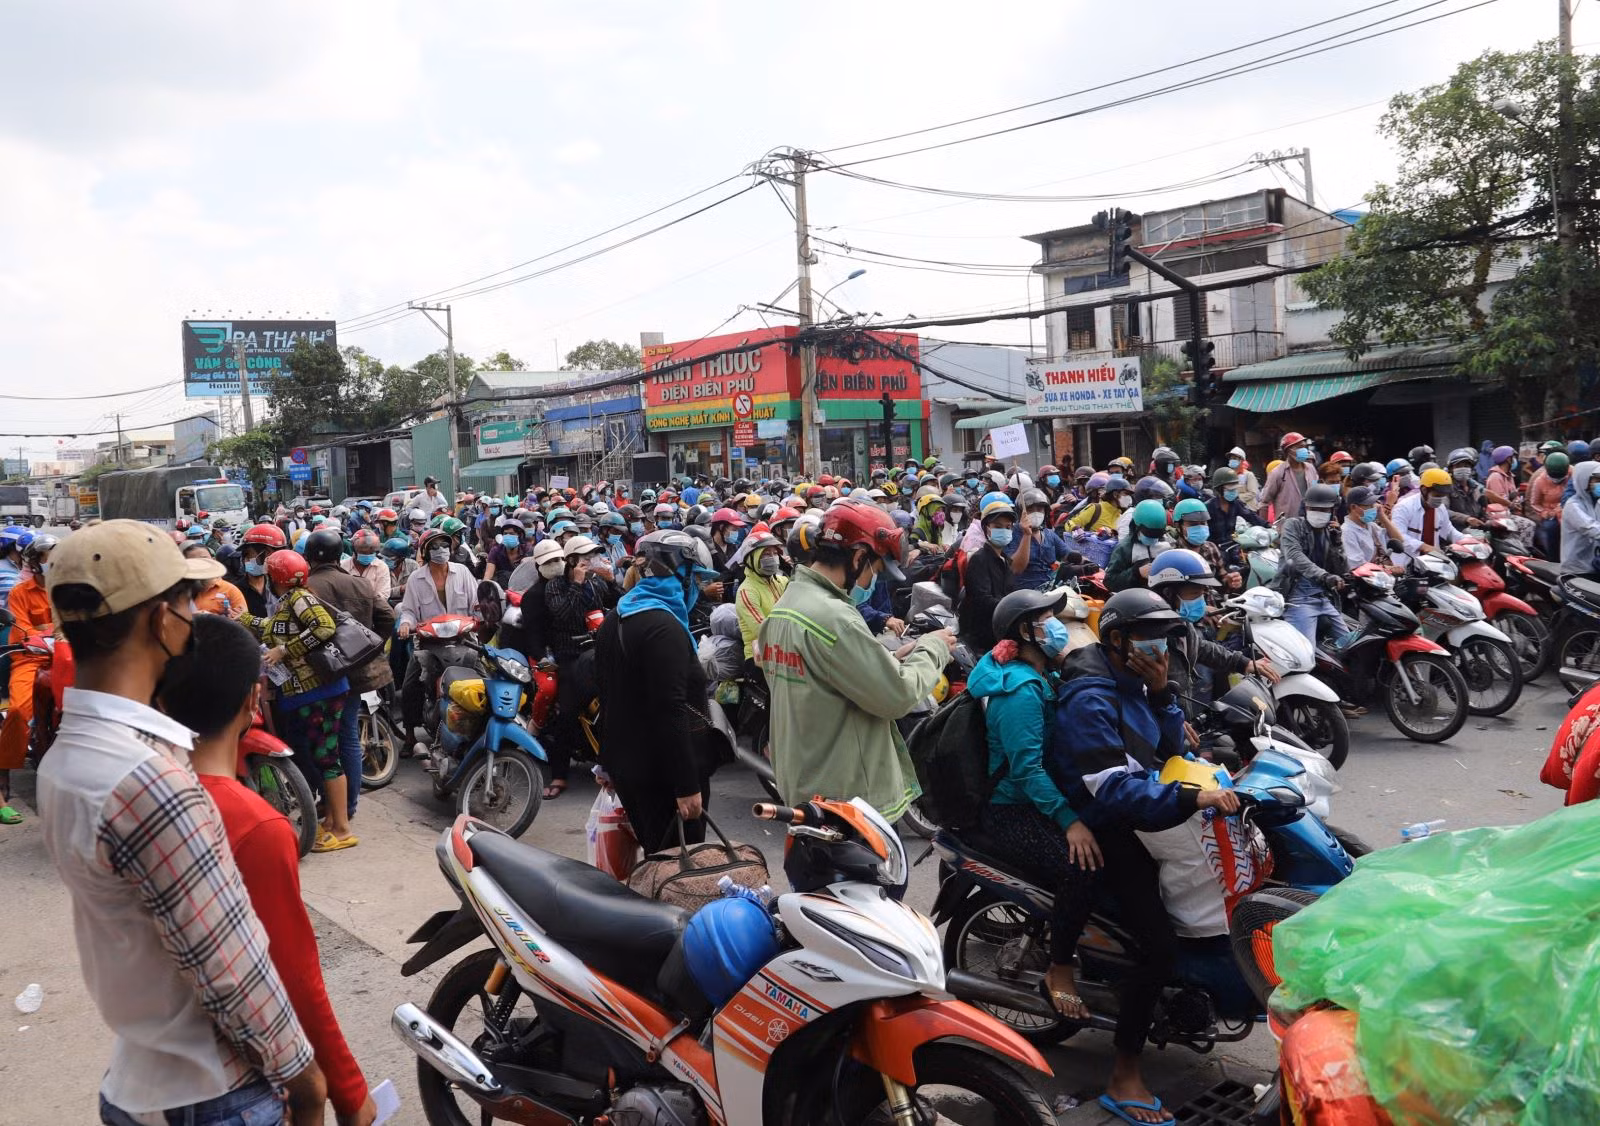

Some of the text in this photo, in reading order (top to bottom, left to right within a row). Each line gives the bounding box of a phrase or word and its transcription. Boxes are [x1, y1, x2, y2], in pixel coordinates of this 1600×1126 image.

[661, 371, 755, 404] ĐIỆN BIÊN PHỦ
[1045, 370, 1085, 385] THANH
[1059, 391, 1068, 402] XE
[1070, 390, 1096, 402] HONDA
[1103, 388, 1112, 399] XE
[1114, 387, 1127, 399] TAY
[764, 983, 809, 1019] YAMAHA
[672, 1058, 699, 1086] YAMAHA
